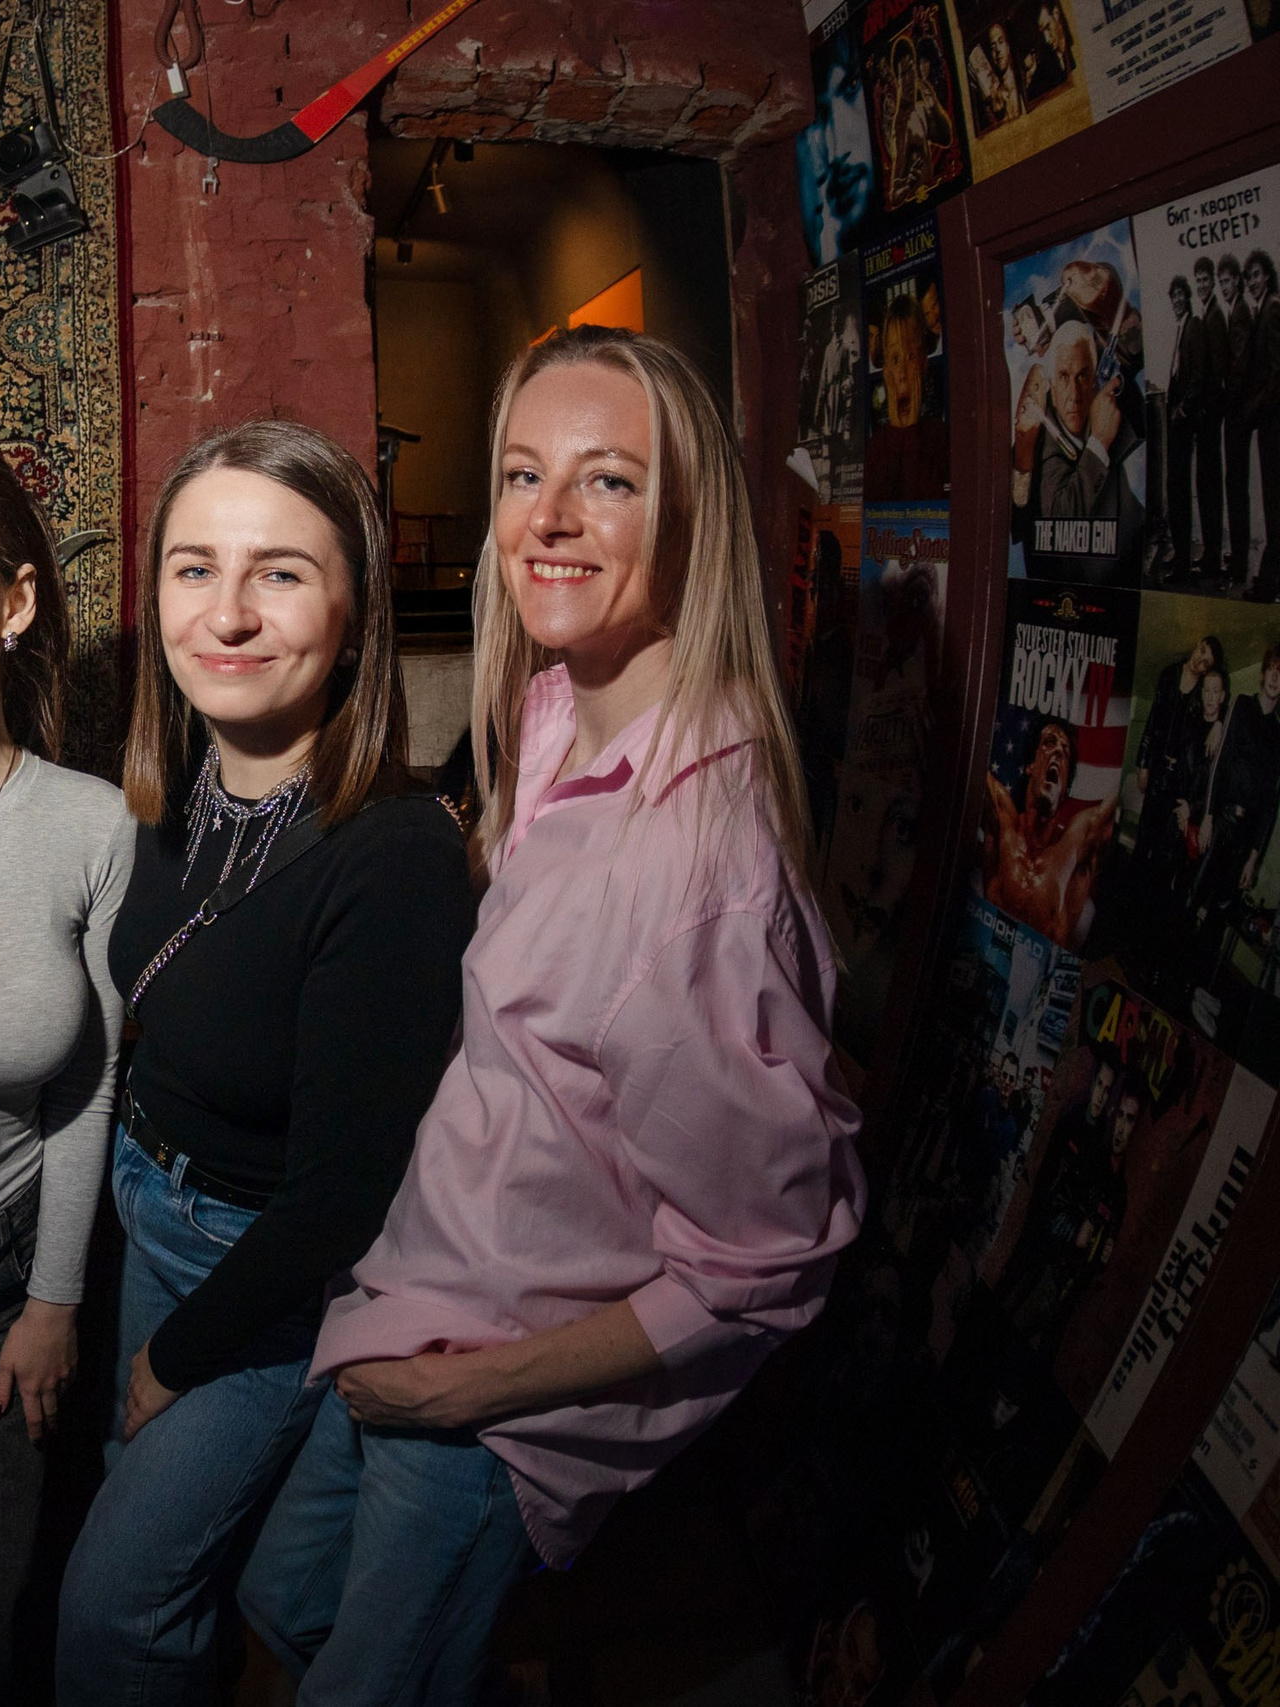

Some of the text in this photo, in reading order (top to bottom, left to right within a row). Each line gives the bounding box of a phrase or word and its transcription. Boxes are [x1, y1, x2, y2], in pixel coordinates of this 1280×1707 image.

[1179, 212, 1260, 249] «СЕКРЕТ»
[1033, 520, 1117, 554] THE NAKED GUN
[1015, 622, 1118, 666] SYLVESTER STALLONE
[1008, 647, 1089, 727] ROCKY
[964, 900, 1044, 960] RADIOHEAD
